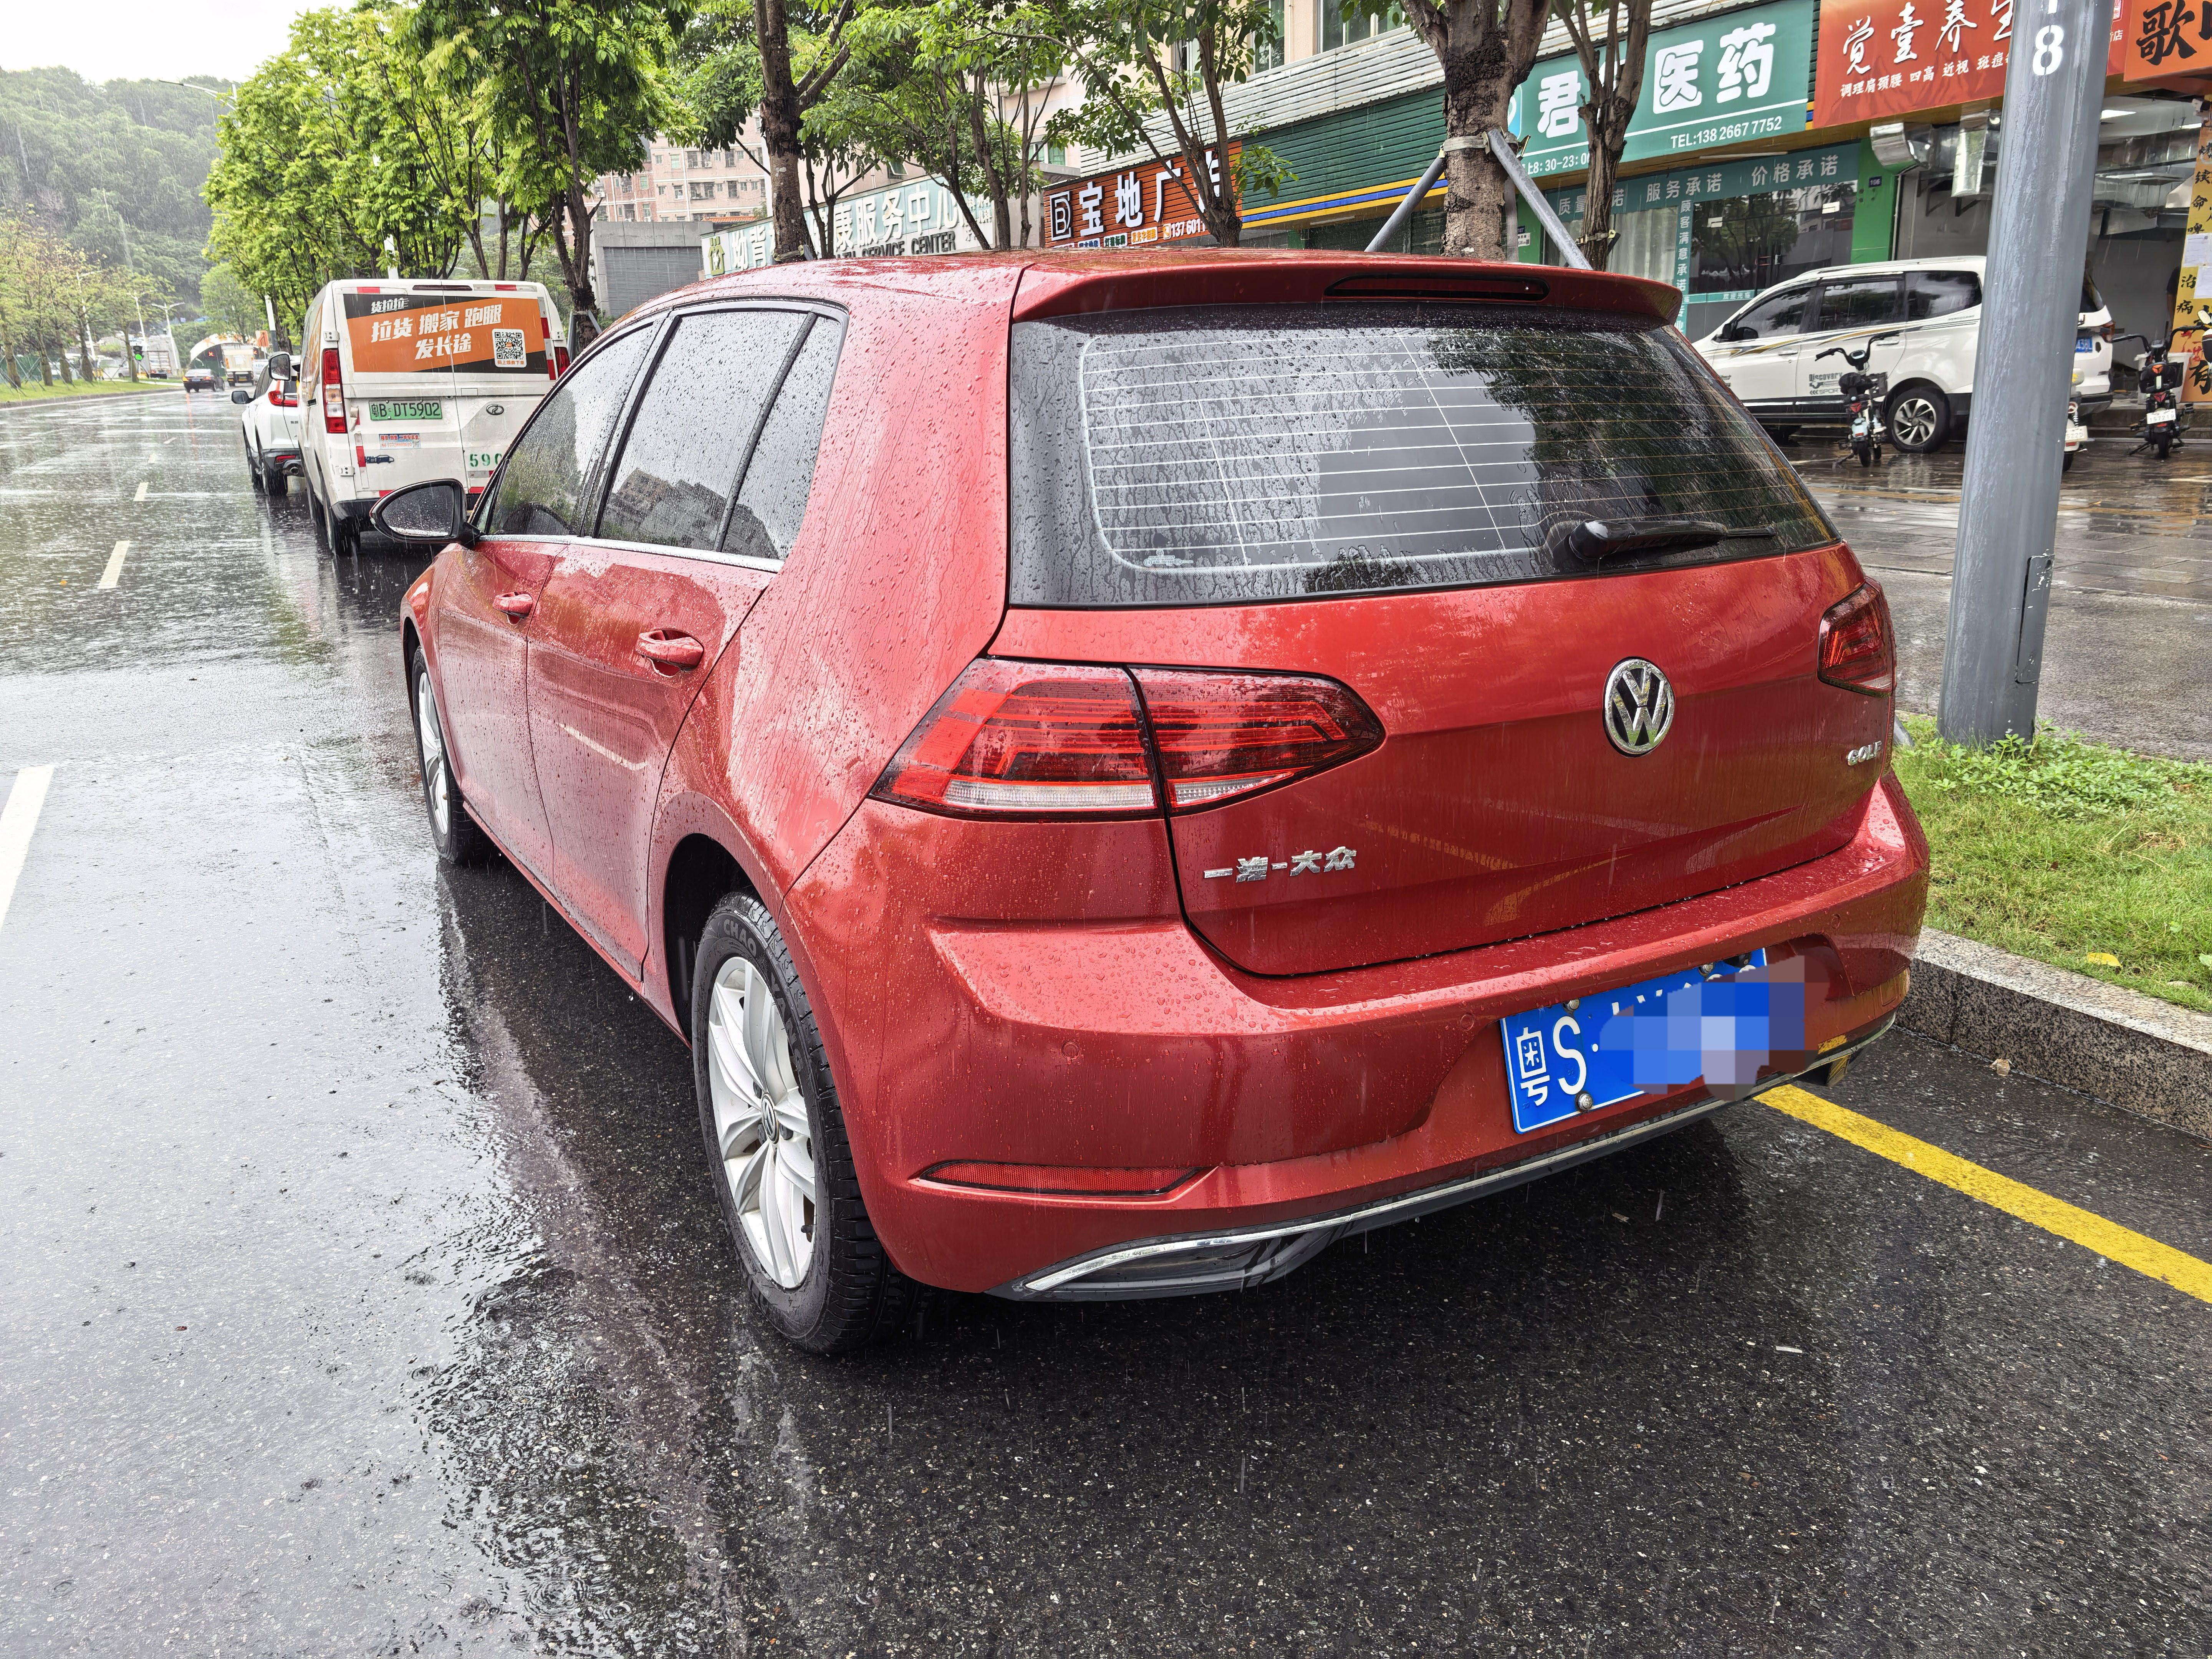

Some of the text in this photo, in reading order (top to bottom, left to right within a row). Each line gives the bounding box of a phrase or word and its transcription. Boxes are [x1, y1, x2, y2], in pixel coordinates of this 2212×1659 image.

[2136, 0, 2212, 66] 歌
[1840, 73, 1903, 98] 调理肩颈腰
[1909, 66, 1935, 82] 四高
[1942, 59, 1969, 78] 近视
[1646, 172, 1722, 203] 服务承诺
[1752, 154, 1838, 187] 价格承诺
[911, 230, 956, 255] CENTER
[371, 297, 409, 314] 货拉拉
[371, 304, 502, 343] 拉货 搬家 跑腿
[414, 333, 471, 360] 发长途
[1847, 740, 1882, 766] GOLF
[723, 919, 757, 957] CHAO
